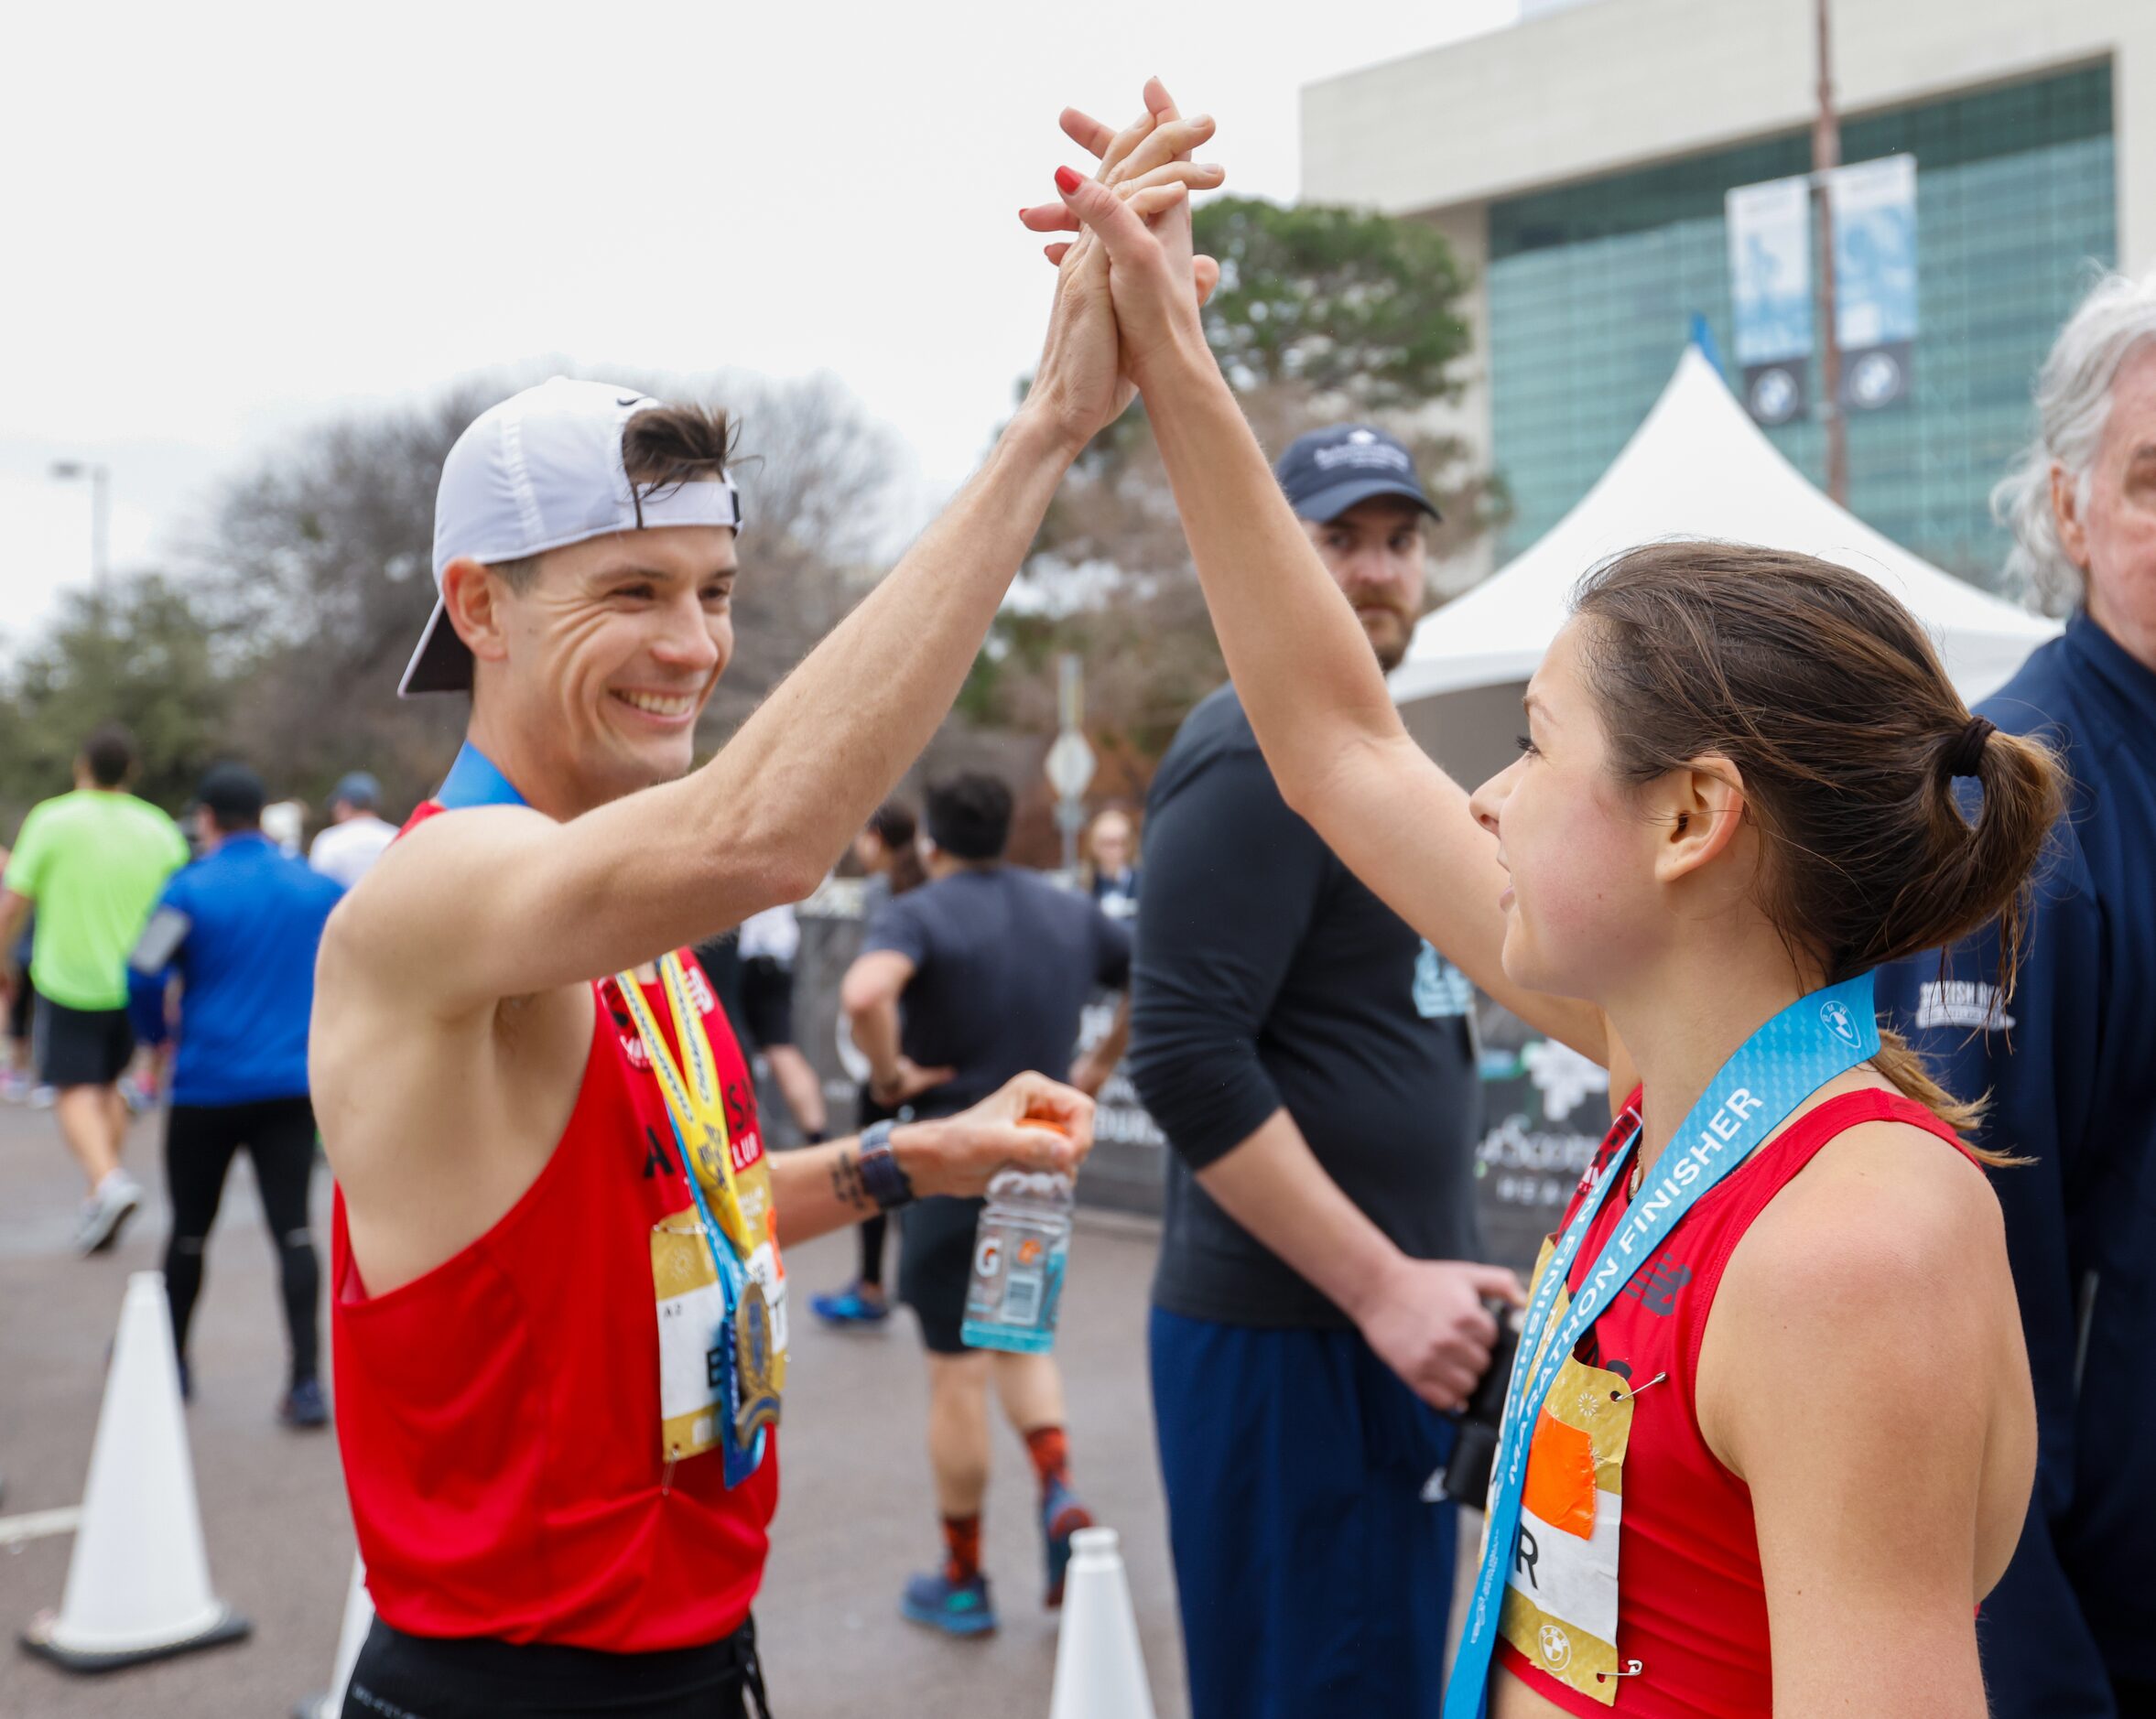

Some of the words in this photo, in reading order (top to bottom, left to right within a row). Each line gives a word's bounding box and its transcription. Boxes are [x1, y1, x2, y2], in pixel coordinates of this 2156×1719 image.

[728, 1131, 759, 1173] LUB
[975, 1238, 1002, 1277] G
[1509, 1257, 1619, 1486] MARATHON
[1618, 1087, 1764, 1255] FINISHER
